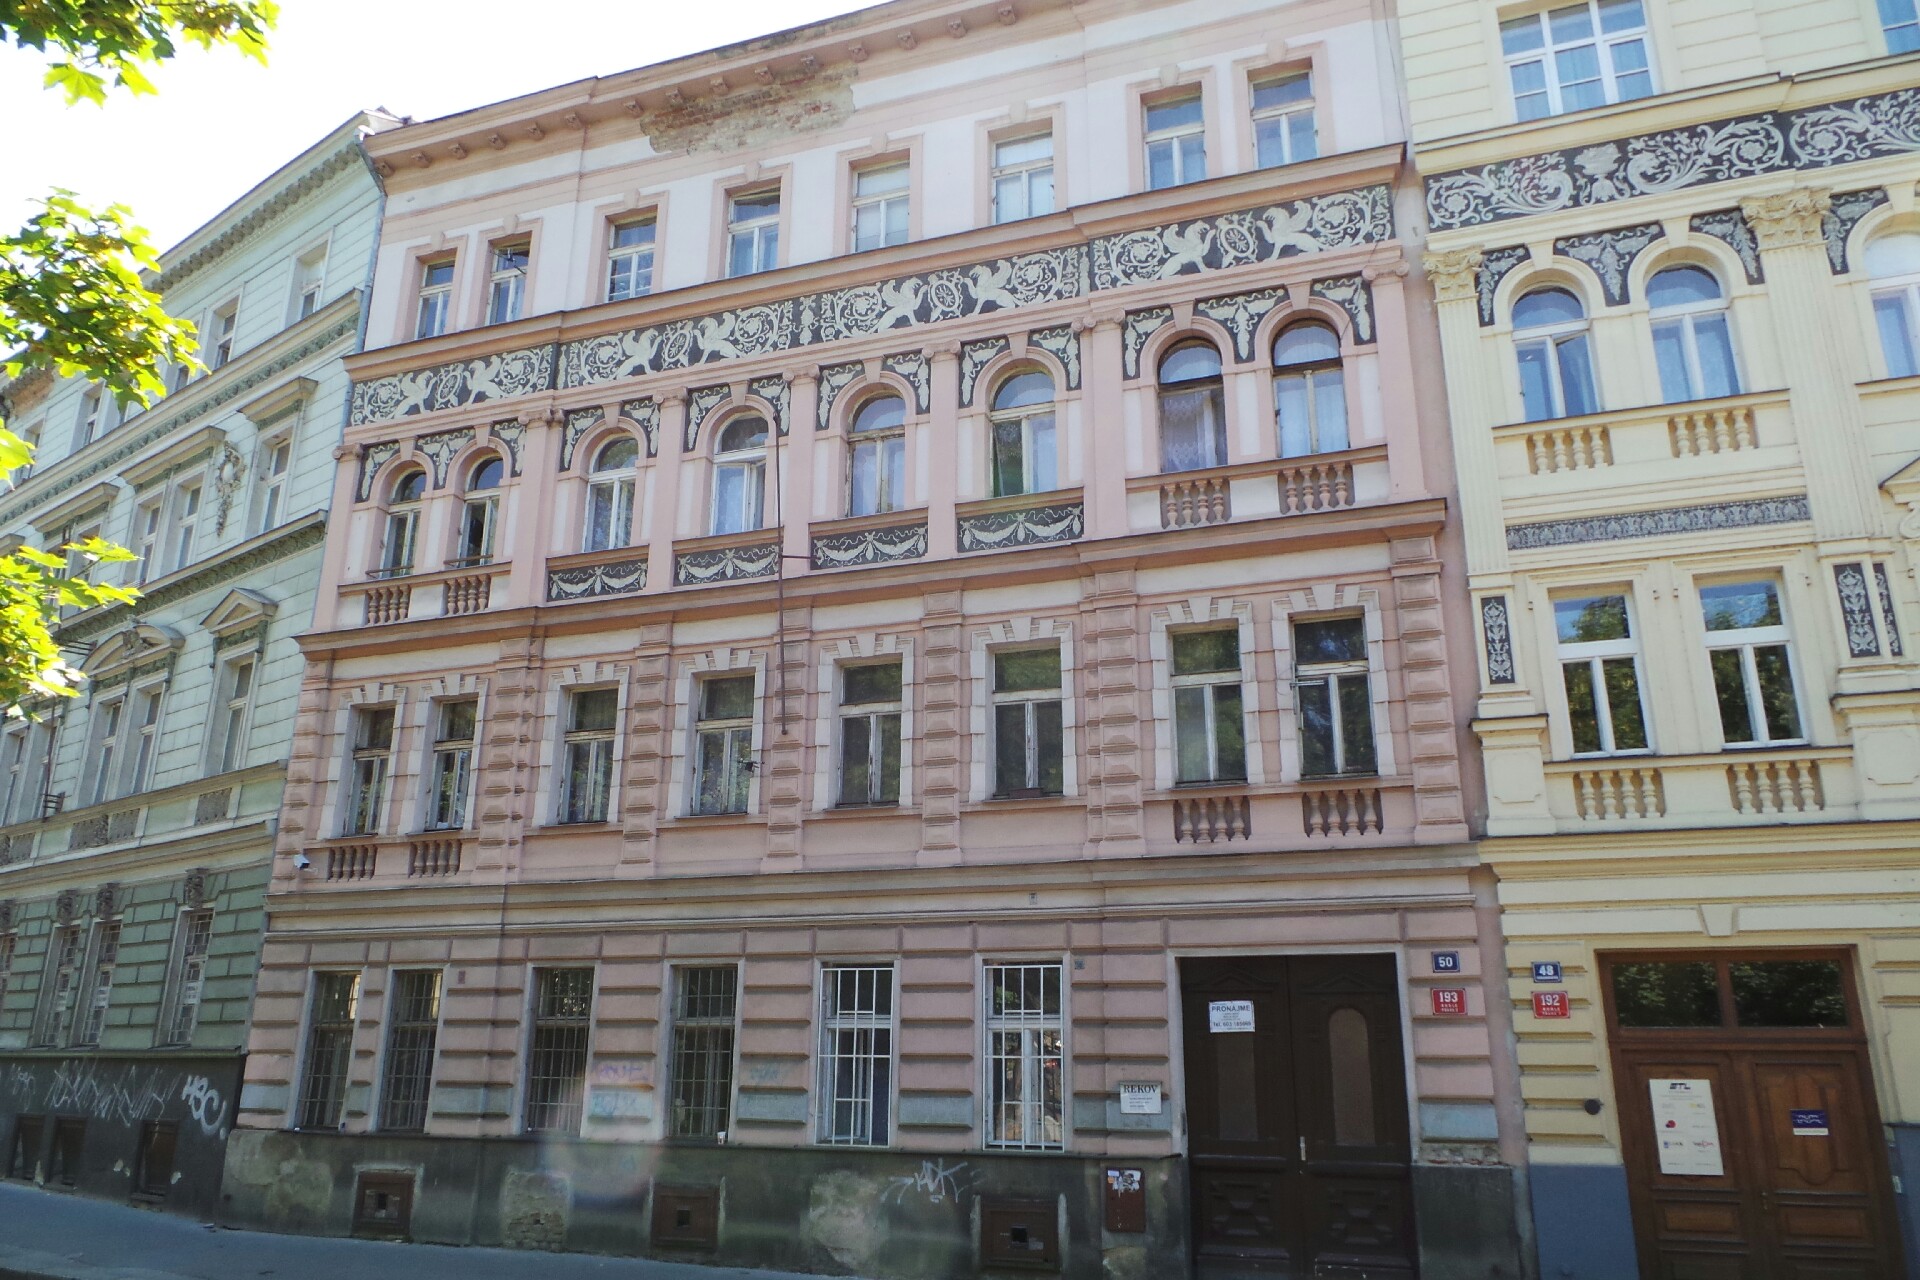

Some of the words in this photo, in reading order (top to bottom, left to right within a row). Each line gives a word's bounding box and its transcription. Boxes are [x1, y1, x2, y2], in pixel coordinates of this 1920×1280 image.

[1438, 956, 1453, 967] 50
[1539, 965, 1554, 976] 48
[1439, 991, 1458, 1003] 193
[1540, 994, 1560, 1006] 192
[1123, 1084, 1157, 1093] REKOV
